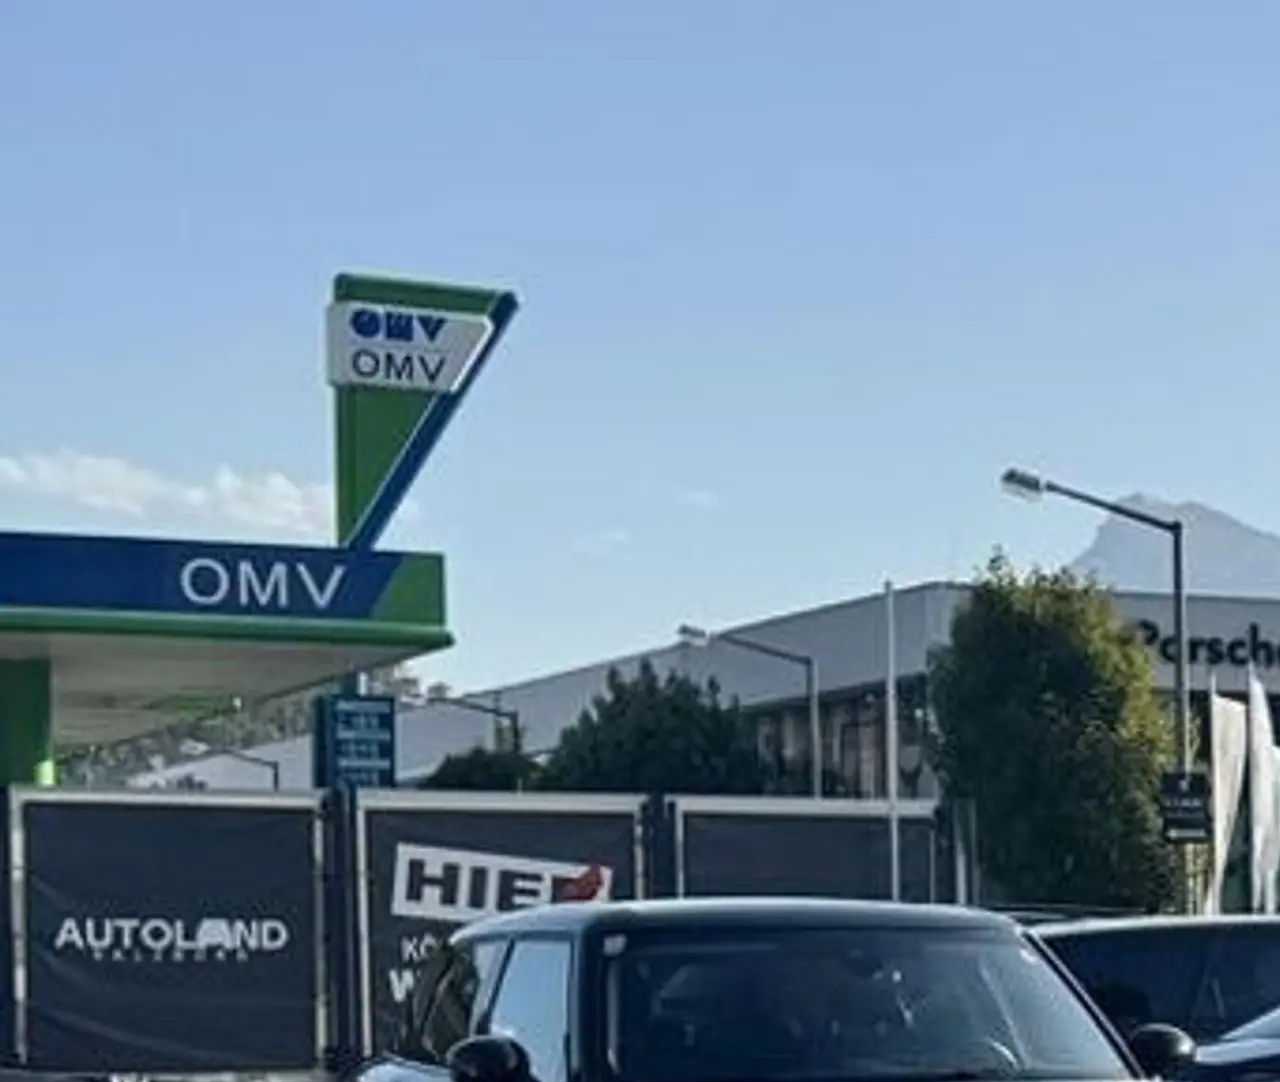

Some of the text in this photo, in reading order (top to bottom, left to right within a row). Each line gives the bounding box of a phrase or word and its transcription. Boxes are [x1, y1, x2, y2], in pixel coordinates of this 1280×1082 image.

[352, 348, 446, 383] OMV
[180, 558, 346, 609] OMV
[55, 917, 290, 950] AUTOLAND
